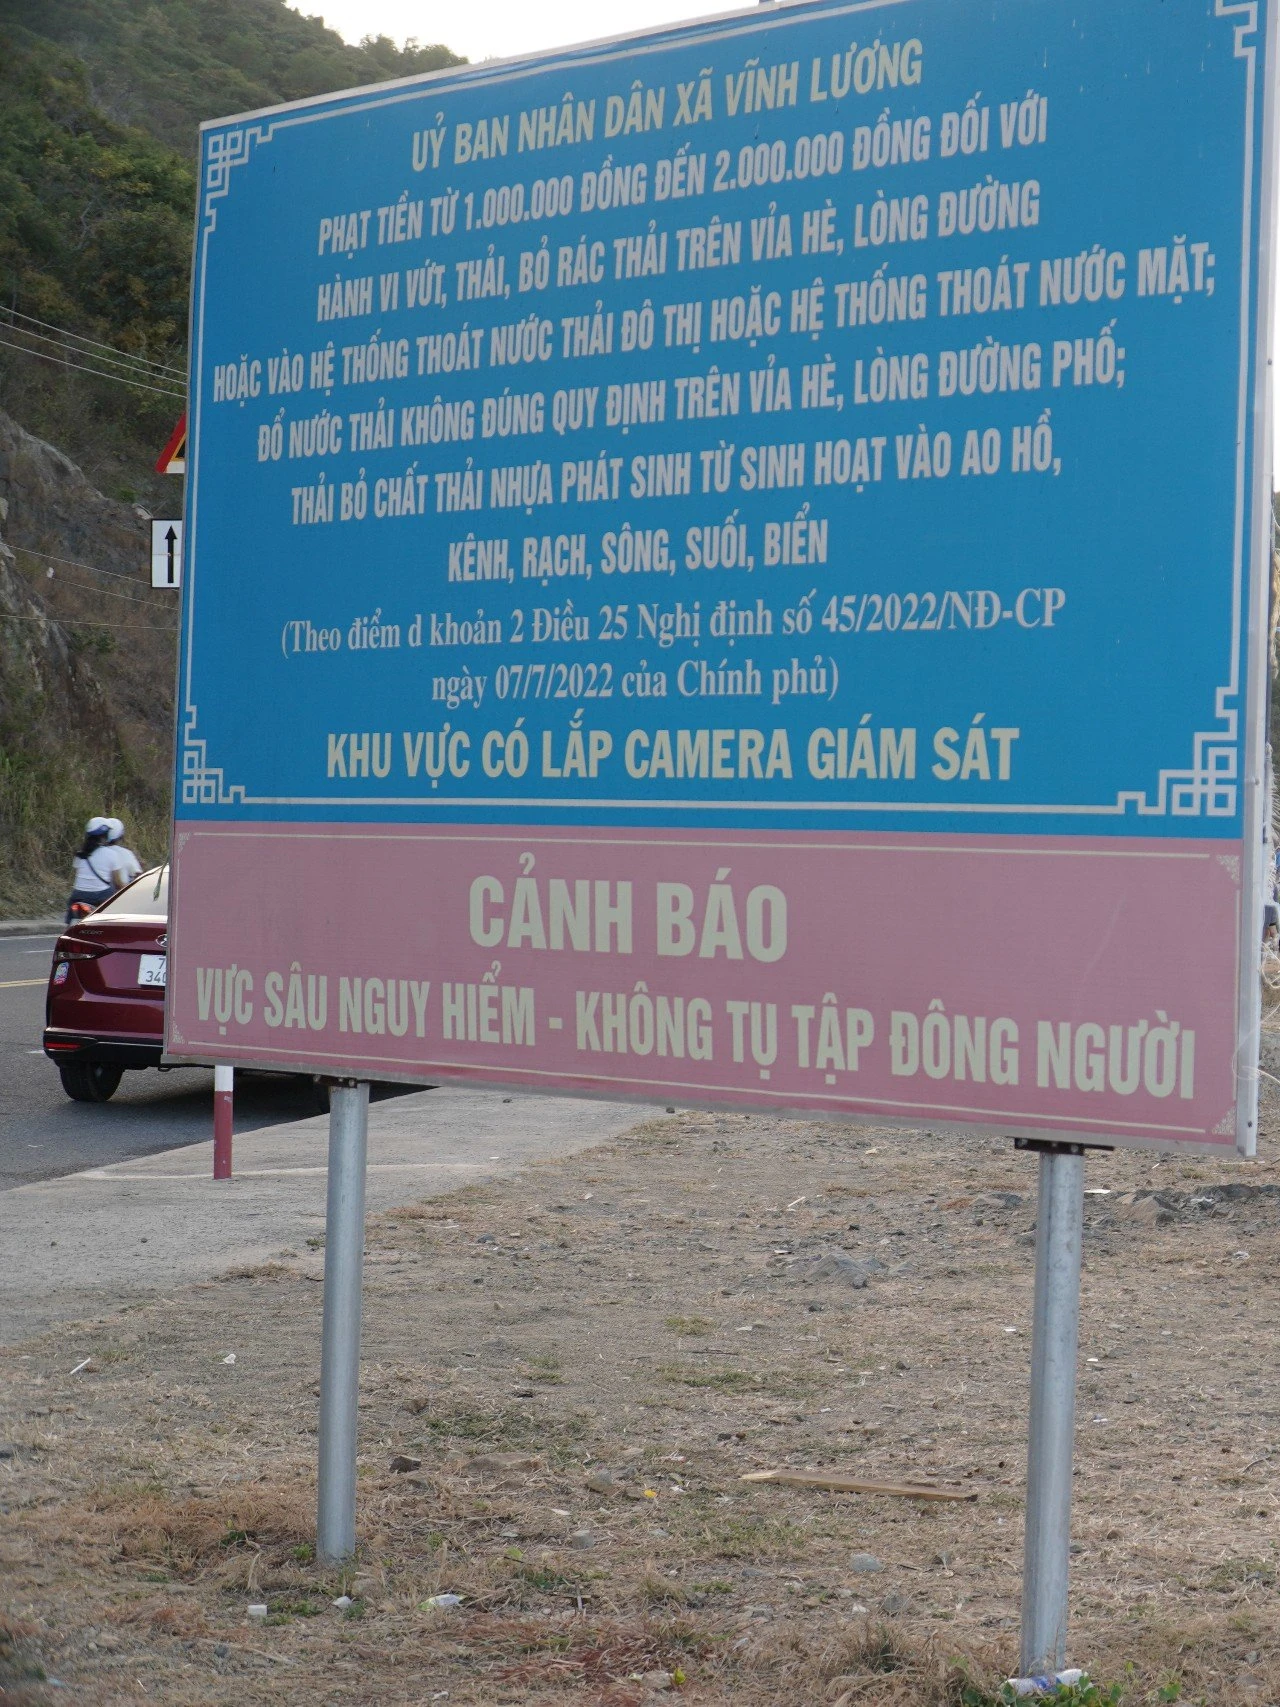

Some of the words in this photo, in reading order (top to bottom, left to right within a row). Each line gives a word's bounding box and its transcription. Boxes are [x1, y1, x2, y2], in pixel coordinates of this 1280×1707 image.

[412, 112, 446, 171] UỶ
[454, 115, 509, 164] BAN
[518, 92, 595, 153] NHÂN
[605, 80, 665, 138] DÂN
[673, 67, 713, 126] XÃ
[726, 57, 799, 116] VĨNH
[810, 38, 922, 102] LƯƠNG
[319, 211, 371, 259] PHẠT
[378, 190, 423, 244] TIỀN
[430, 187, 459, 236] TỪ
[465, 175, 574, 230] 1.000.000
[580, 155, 647, 212] ĐỒNG
[655, 142, 706, 201] ĐẾN
[713, 131, 844, 192] 2.000.000
[853, 107, 931, 170] ĐỒNG
[940, 92, 989, 157] ĐỐI
[1000, 89, 1047, 148] VỚI
[318, 274, 372, 321] HÀNH
[380, 272, 399, 311] VI
[407, 259, 446, 308] VỨT,
[456, 244, 510, 301] THẢI,
[519, 235, 549, 292] BỎ
[557, 235, 605, 287] RÁC
[614, 220, 667, 279] THẢI
[676, 216, 741, 271] TRÊN
[751, 201, 792, 261] VỈA
[802, 199, 843, 255] HÈ,
[854, 190, 928, 247] LÒNG
[938, 175, 1040, 237] ĐƯỜNG
[214, 355, 261, 406] HOẶC
[268, 349, 303, 394] VÀO
[310, 342, 335, 395] HỆ
[342, 329, 408, 384] THỐNG
[416, 323, 484, 375] THOÁT
[490, 313, 553, 366] NƯỚC
[562, 300, 613, 357] THẢI
[621, 299, 654, 351] ĐÔ
[663, 302, 701, 353] THỊ
[710, 285, 781, 347] HOẶC
[791, 277, 824, 340] HỆ
[835, 262, 927, 327] THỐNG
[937, 255, 1030, 316] THOÁT
[1040, 244, 1125, 306] NƯỚC
[1138, 235, 1215, 303] MẶT;
[258, 408, 284, 461] ĐỔ
[289, 409, 342, 458] NƯỚC
[350, 397, 394, 451] THẢI
[401, 396, 474, 446] KHÔNG
[482, 388, 544, 437] ĐÚNG
[553, 387, 598, 435] QUY
[606, 380, 665, 434] ĐỊNH
[675, 366, 740, 419] TRÊN
[750, 354, 791, 413] VỈA
[802, 354, 843, 411] HÈ,
[855, 347, 928, 404] LÒNG
[938, 336, 1041, 396] ĐƯỜNG
[1053, 319, 1125, 388] PHỐ;
[292, 472, 333, 524] THẢI
[341, 468, 367, 520] BỎ
[375, 462, 428, 517] CHẤT
[435, 457, 483, 512] THẢI
[491, 460, 553, 514] NHỰA
[561, 450, 623, 502] PHÁT
[631, 452, 691, 498] SINH
[700, 440, 734, 492] TỪ
[740, 443, 805, 490] SINH
[815, 437, 886, 492] HOẠT
[896, 424, 951, 479] VÀO
[961, 428, 1001, 475] AO
[1012, 408, 1061, 475] HỒ,
[449, 533, 513, 583] KÊNH,
[523, 534, 592, 586] RẠCH,
[601, 523, 675, 575] SÔNG,
[686, 509, 754, 571] SUỐI,
[764, 502, 827, 566] BIỂN
[282, 621, 342, 659] (Theo
[348, 608, 400, 649] điểm
[409, 615, 421, 647] d
[430, 610, 502, 648] khoản
[510, 609, 523, 642] 2
[532, 599, 589, 641] Điều
[599, 605, 628, 639] 25
[638, 602, 699, 647] Nghị
[710, 599, 772, 646] định
[783, 589, 816, 634] số
[822, 588, 1065, 632] 45/2022/NĐ-CP
[433, 666, 487, 708] ngày
[496, 663, 612, 698] 07/7/2022
[622, 660, 666, 697] của
[678, 659, 761, 696] Chính
[772, 655, 838, 704] phủ)
[328, 733, 391, 777] KHU
[404, 723, 470, 787] VỰC
[482, 718, 529, 777] CÓ
[543, 709, 612, 777] LẮP
[625, 729, 792, 778] CAMERA
[808, 714, 916, 779] GIÁM
[932, 713, 1019, 780] SÁT
[468, 851, 633, 955] CẢNH
[656, 867, 788, 964] BÁO
[195, 962, 254, 1036] VỰC
[262, 960, 328, 1030] SÂU
[338, 976, 430, 1038] NGUY
[440, 960, 536, 1047] HIỂM
[575, 980, 714, 1060] KHÔNG
[724, 1000, 777, 1080] TỤ
[790, 992, 874, 1085] TẬP
[888, 999, 1020, 1085] ĐÔNG
[1036, 1009, 1197, 1100] NGƯỜI
